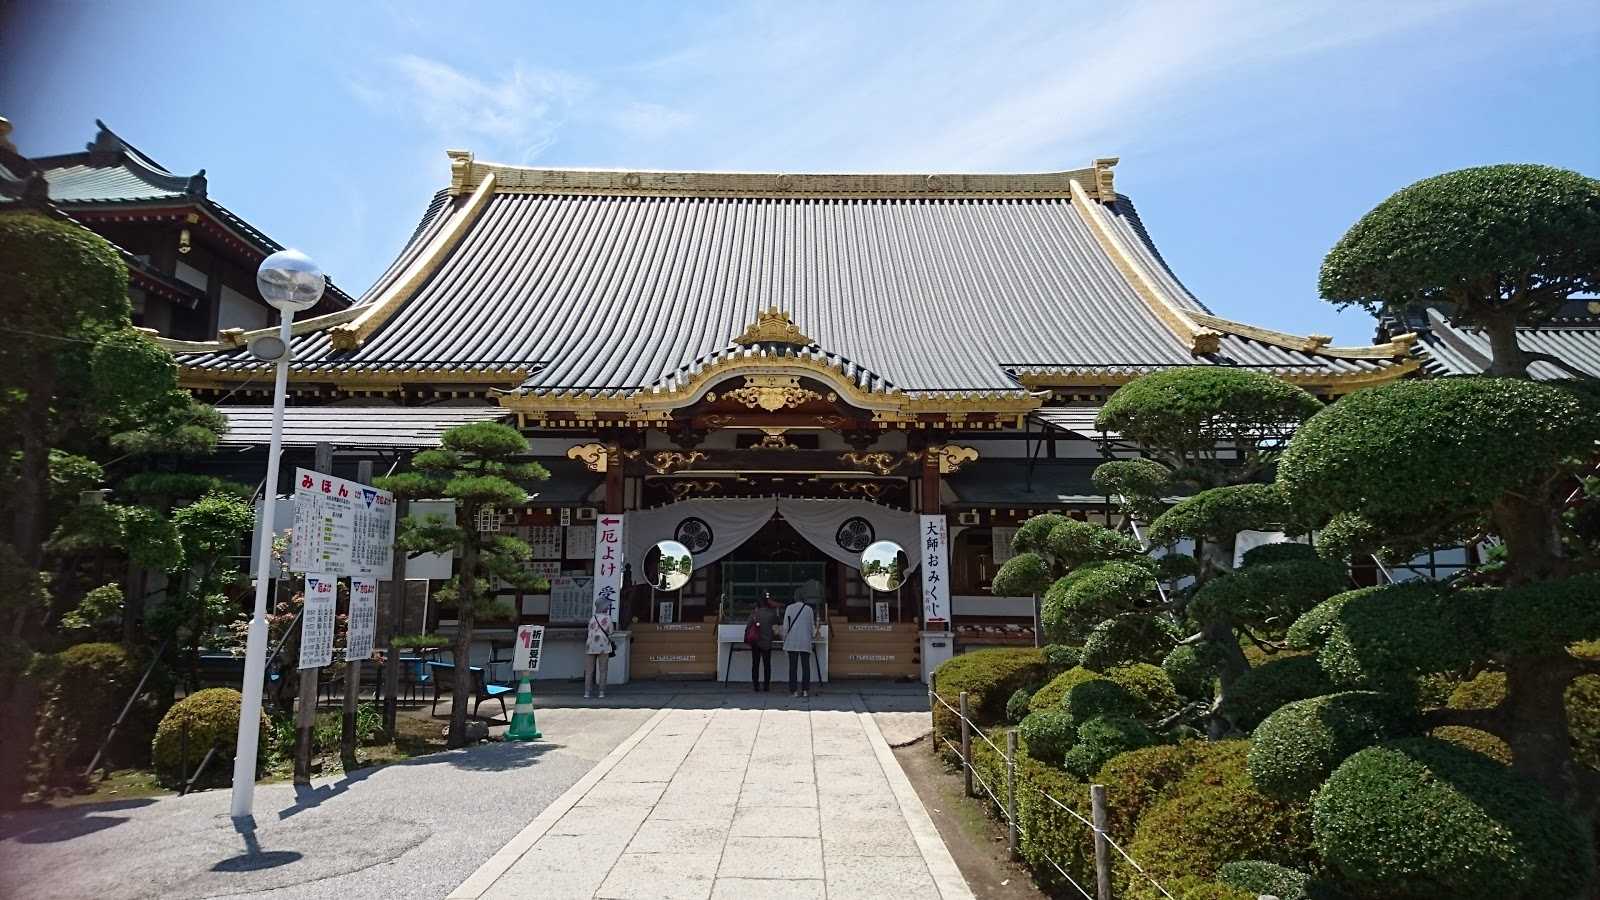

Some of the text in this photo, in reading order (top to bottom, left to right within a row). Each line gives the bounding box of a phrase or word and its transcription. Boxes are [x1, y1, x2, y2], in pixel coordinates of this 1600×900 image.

[302, 474, 348, 498] みほん
[600, 529, 618, 577] 厄よけ
[926, 521, 940, 616] 大師おみくじ
